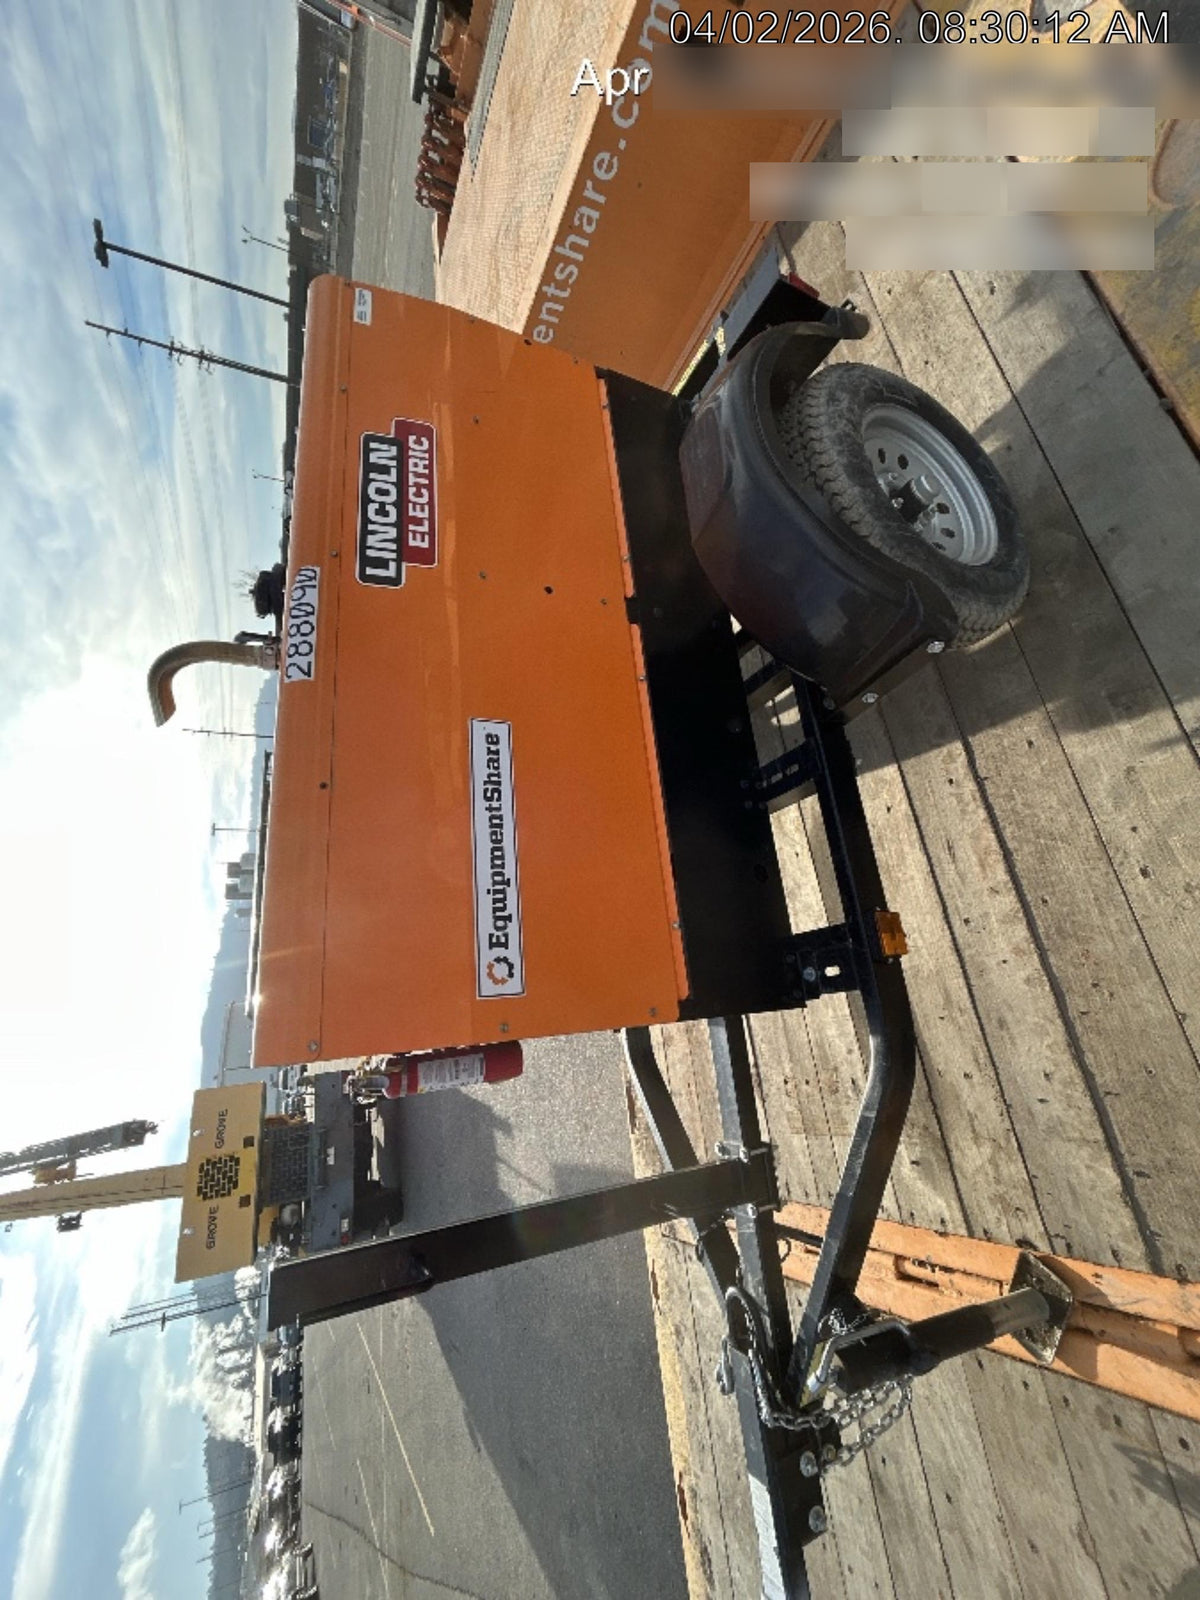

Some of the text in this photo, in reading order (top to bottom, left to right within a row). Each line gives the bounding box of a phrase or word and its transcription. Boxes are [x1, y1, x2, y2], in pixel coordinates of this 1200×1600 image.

[366, 442, 398, 578] LINCOLN
[408, 434, 430, 548] ELECTRIC
[286, 568, 317, 678] 288090
[483, 732, 513, 950] EquipmentShare
[214, 1108, 228, 1149] GROVE
[205, 1204, 220, 1250] GROVE
